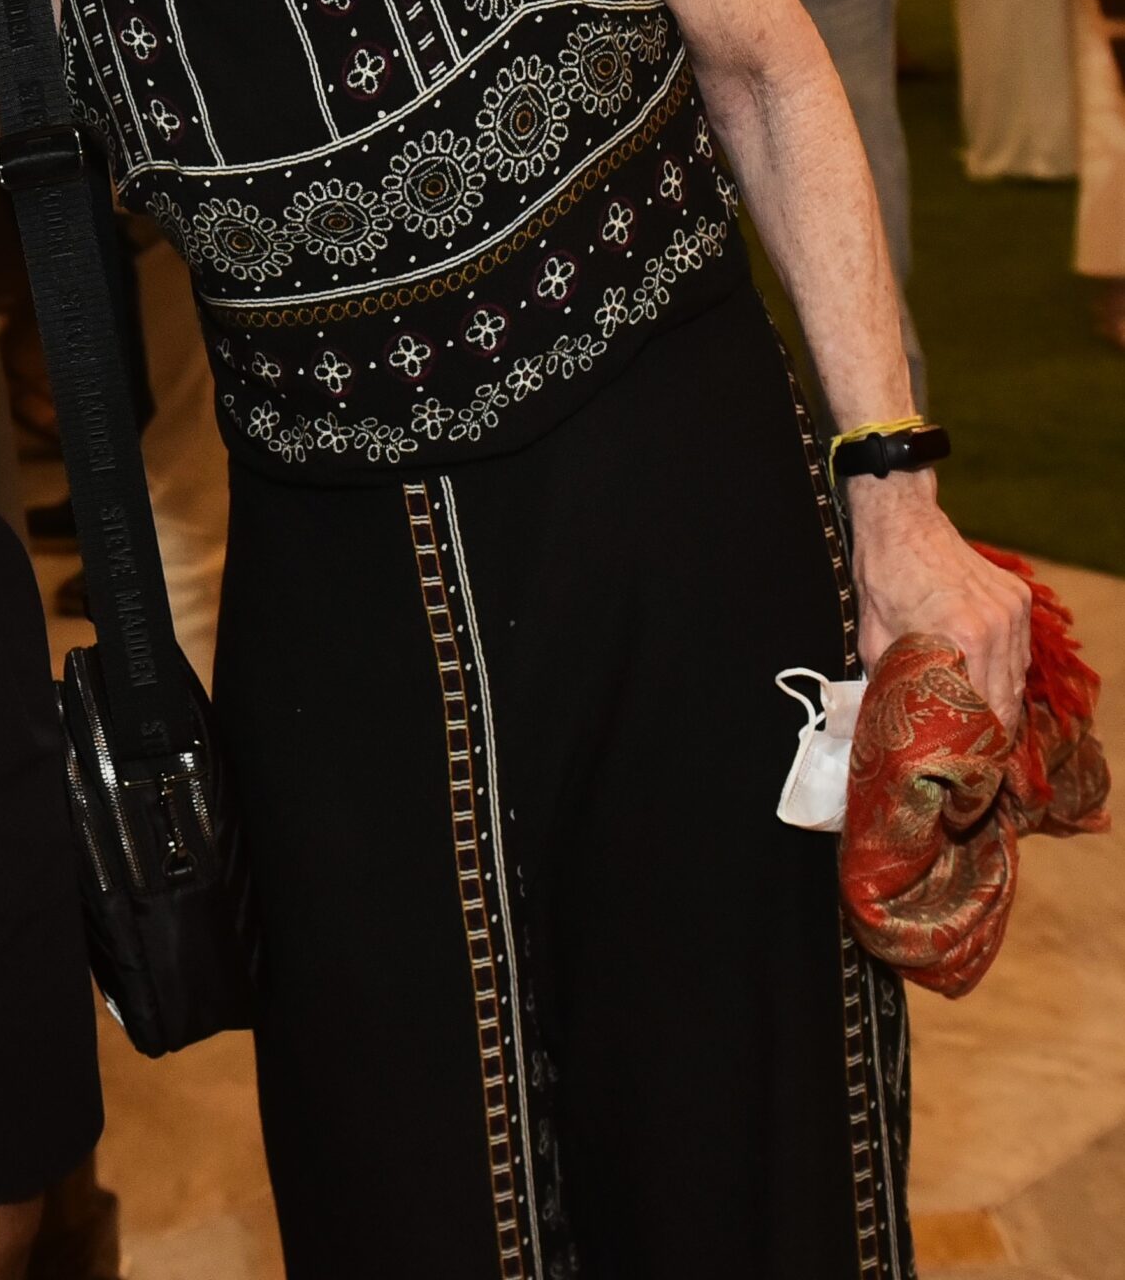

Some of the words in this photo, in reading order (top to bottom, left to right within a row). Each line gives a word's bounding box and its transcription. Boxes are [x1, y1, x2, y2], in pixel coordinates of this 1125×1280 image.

[74, 374, 116, 472] MADDEN
[97, 502, 138, 578] STEVE
[114, 588, 158, 688] MADDEN
